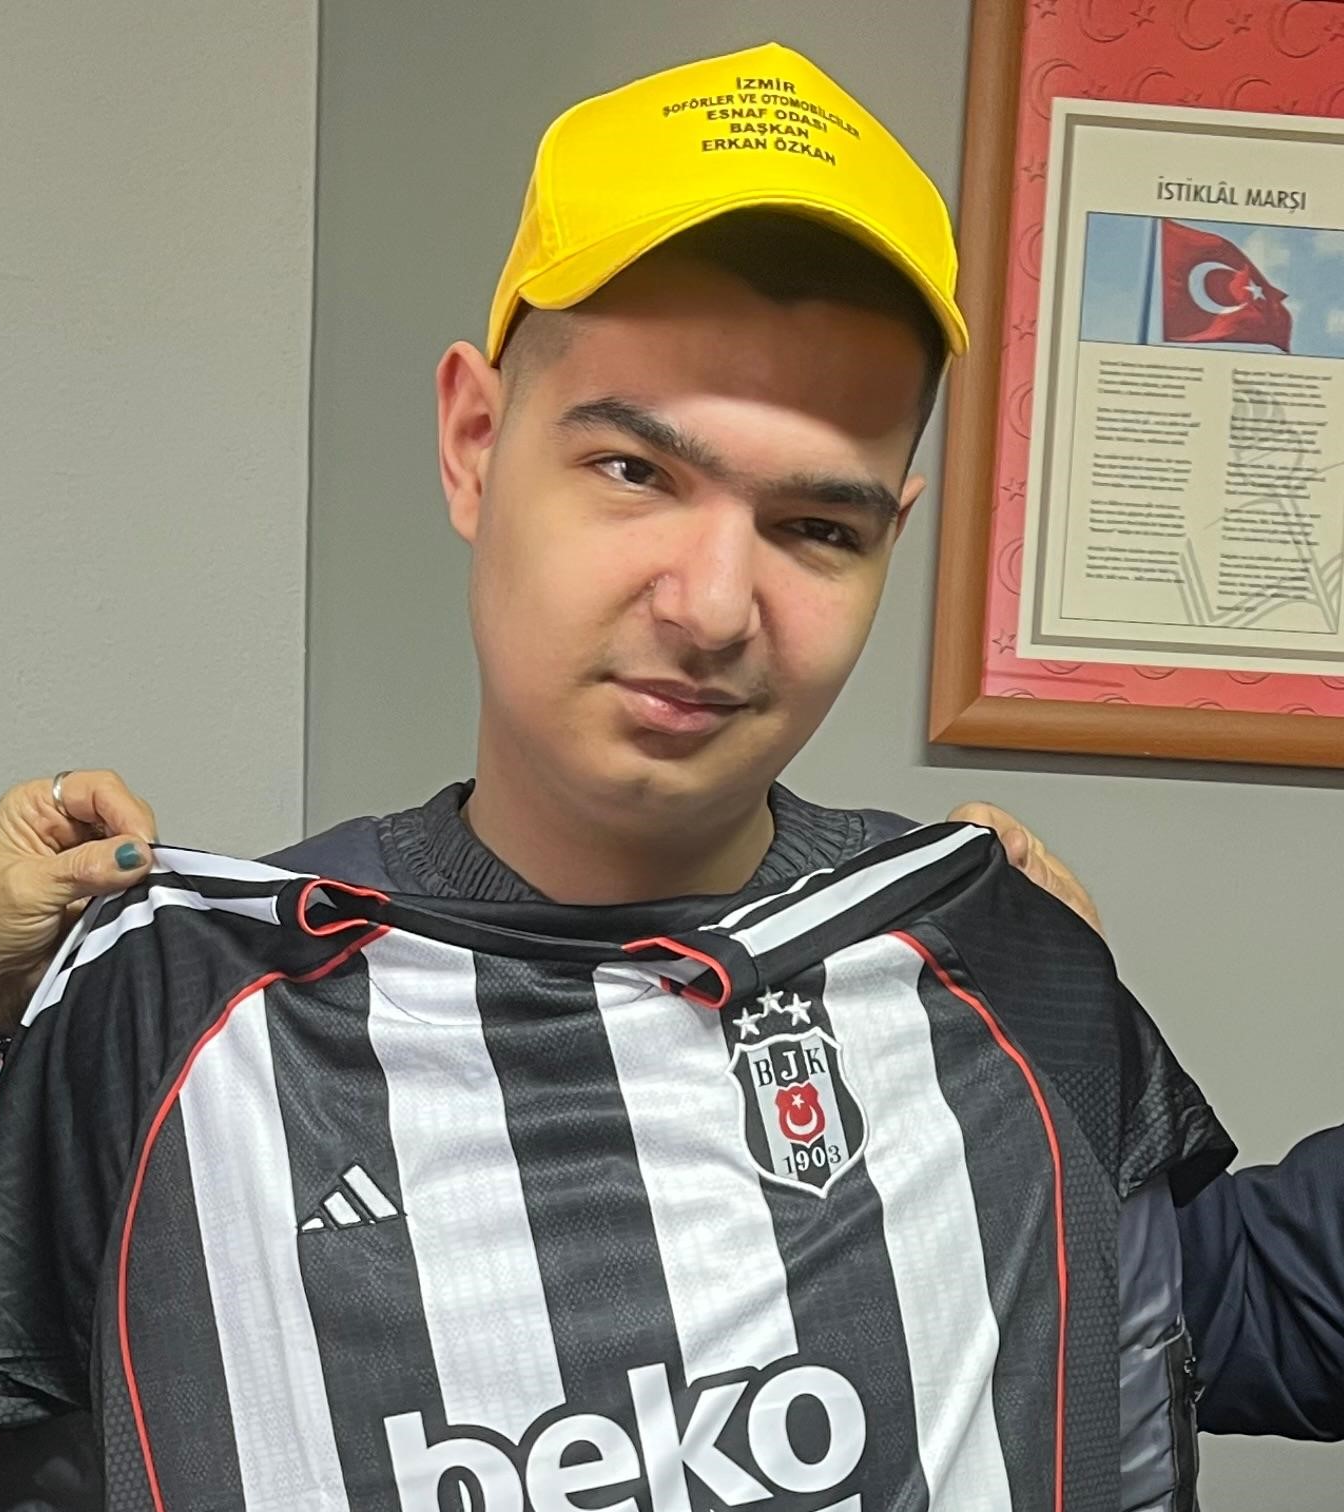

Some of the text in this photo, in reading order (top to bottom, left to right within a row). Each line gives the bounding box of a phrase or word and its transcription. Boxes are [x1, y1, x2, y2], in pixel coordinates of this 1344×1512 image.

[735, 76, 796, 94] İZMİR
[662, 94, 734, 117] ŞOFÖRLER
[738, 93, 757, 104] VE
[706, 107, 828, 133] ESNAF ODASI
[729, 122, 809, 139] BAŞKAN
[701, 137, 836, 166] ERKAN ÖZKAN
[1156, 175, 1307, 214] İSTİKLÂL MARŞI
[753, 1047, 826, 1087] BJK
[782, 1144, 842, 1175] 1903
